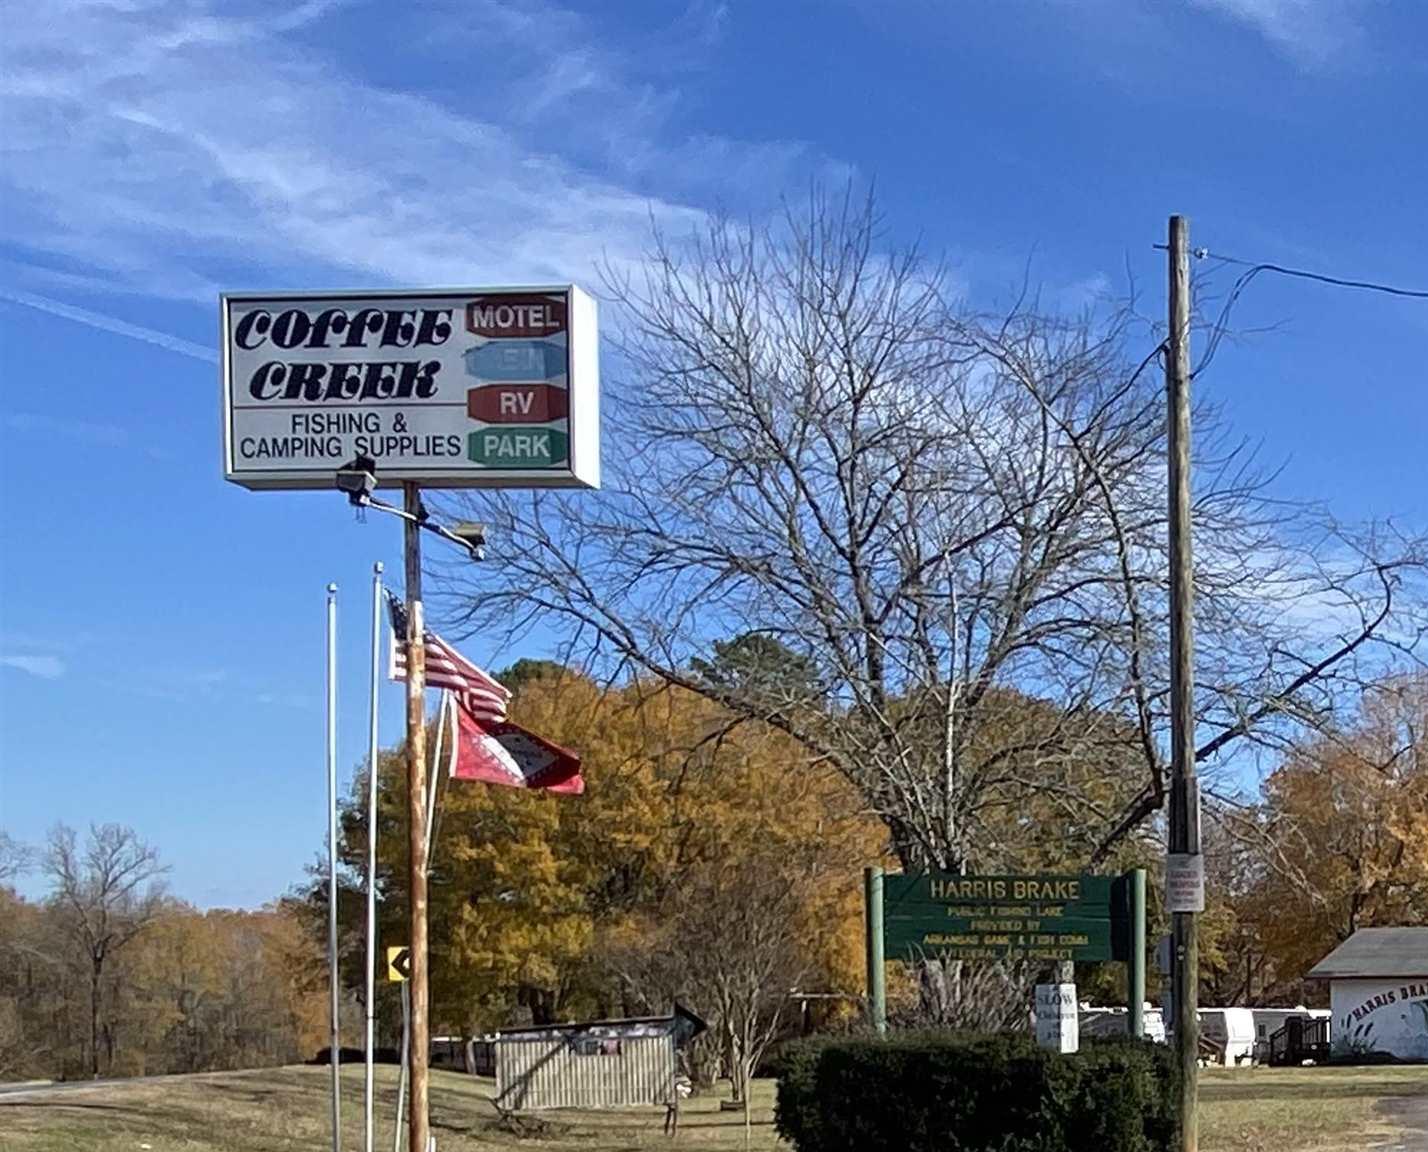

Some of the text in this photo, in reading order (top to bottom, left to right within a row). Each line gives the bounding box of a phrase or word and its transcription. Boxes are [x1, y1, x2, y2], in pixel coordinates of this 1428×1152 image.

[473, 305, 560, 328] MOTEL
[235, 308, 453, 350] COFFEE
[250, 360, 441, 401] CREEK
[500, 392, 535, 414] RV
[291, 413, 408, 434] FISHING &
[240, 434, 461, 459] CAMPING SUPPLIES
[484, 435, 550, 457] PARK
[931, 880, 1080, 899] HARRIS BRAKE
[948, 906, 985, 917] PUBLIC
[1036, 906, 1064, 917] LAKE
[971, 920, 1022, 931] PROVIDED
[923, 934, 979, 945] ARKANSAS
[1352, 990, 1396, 1022] HARRIS
